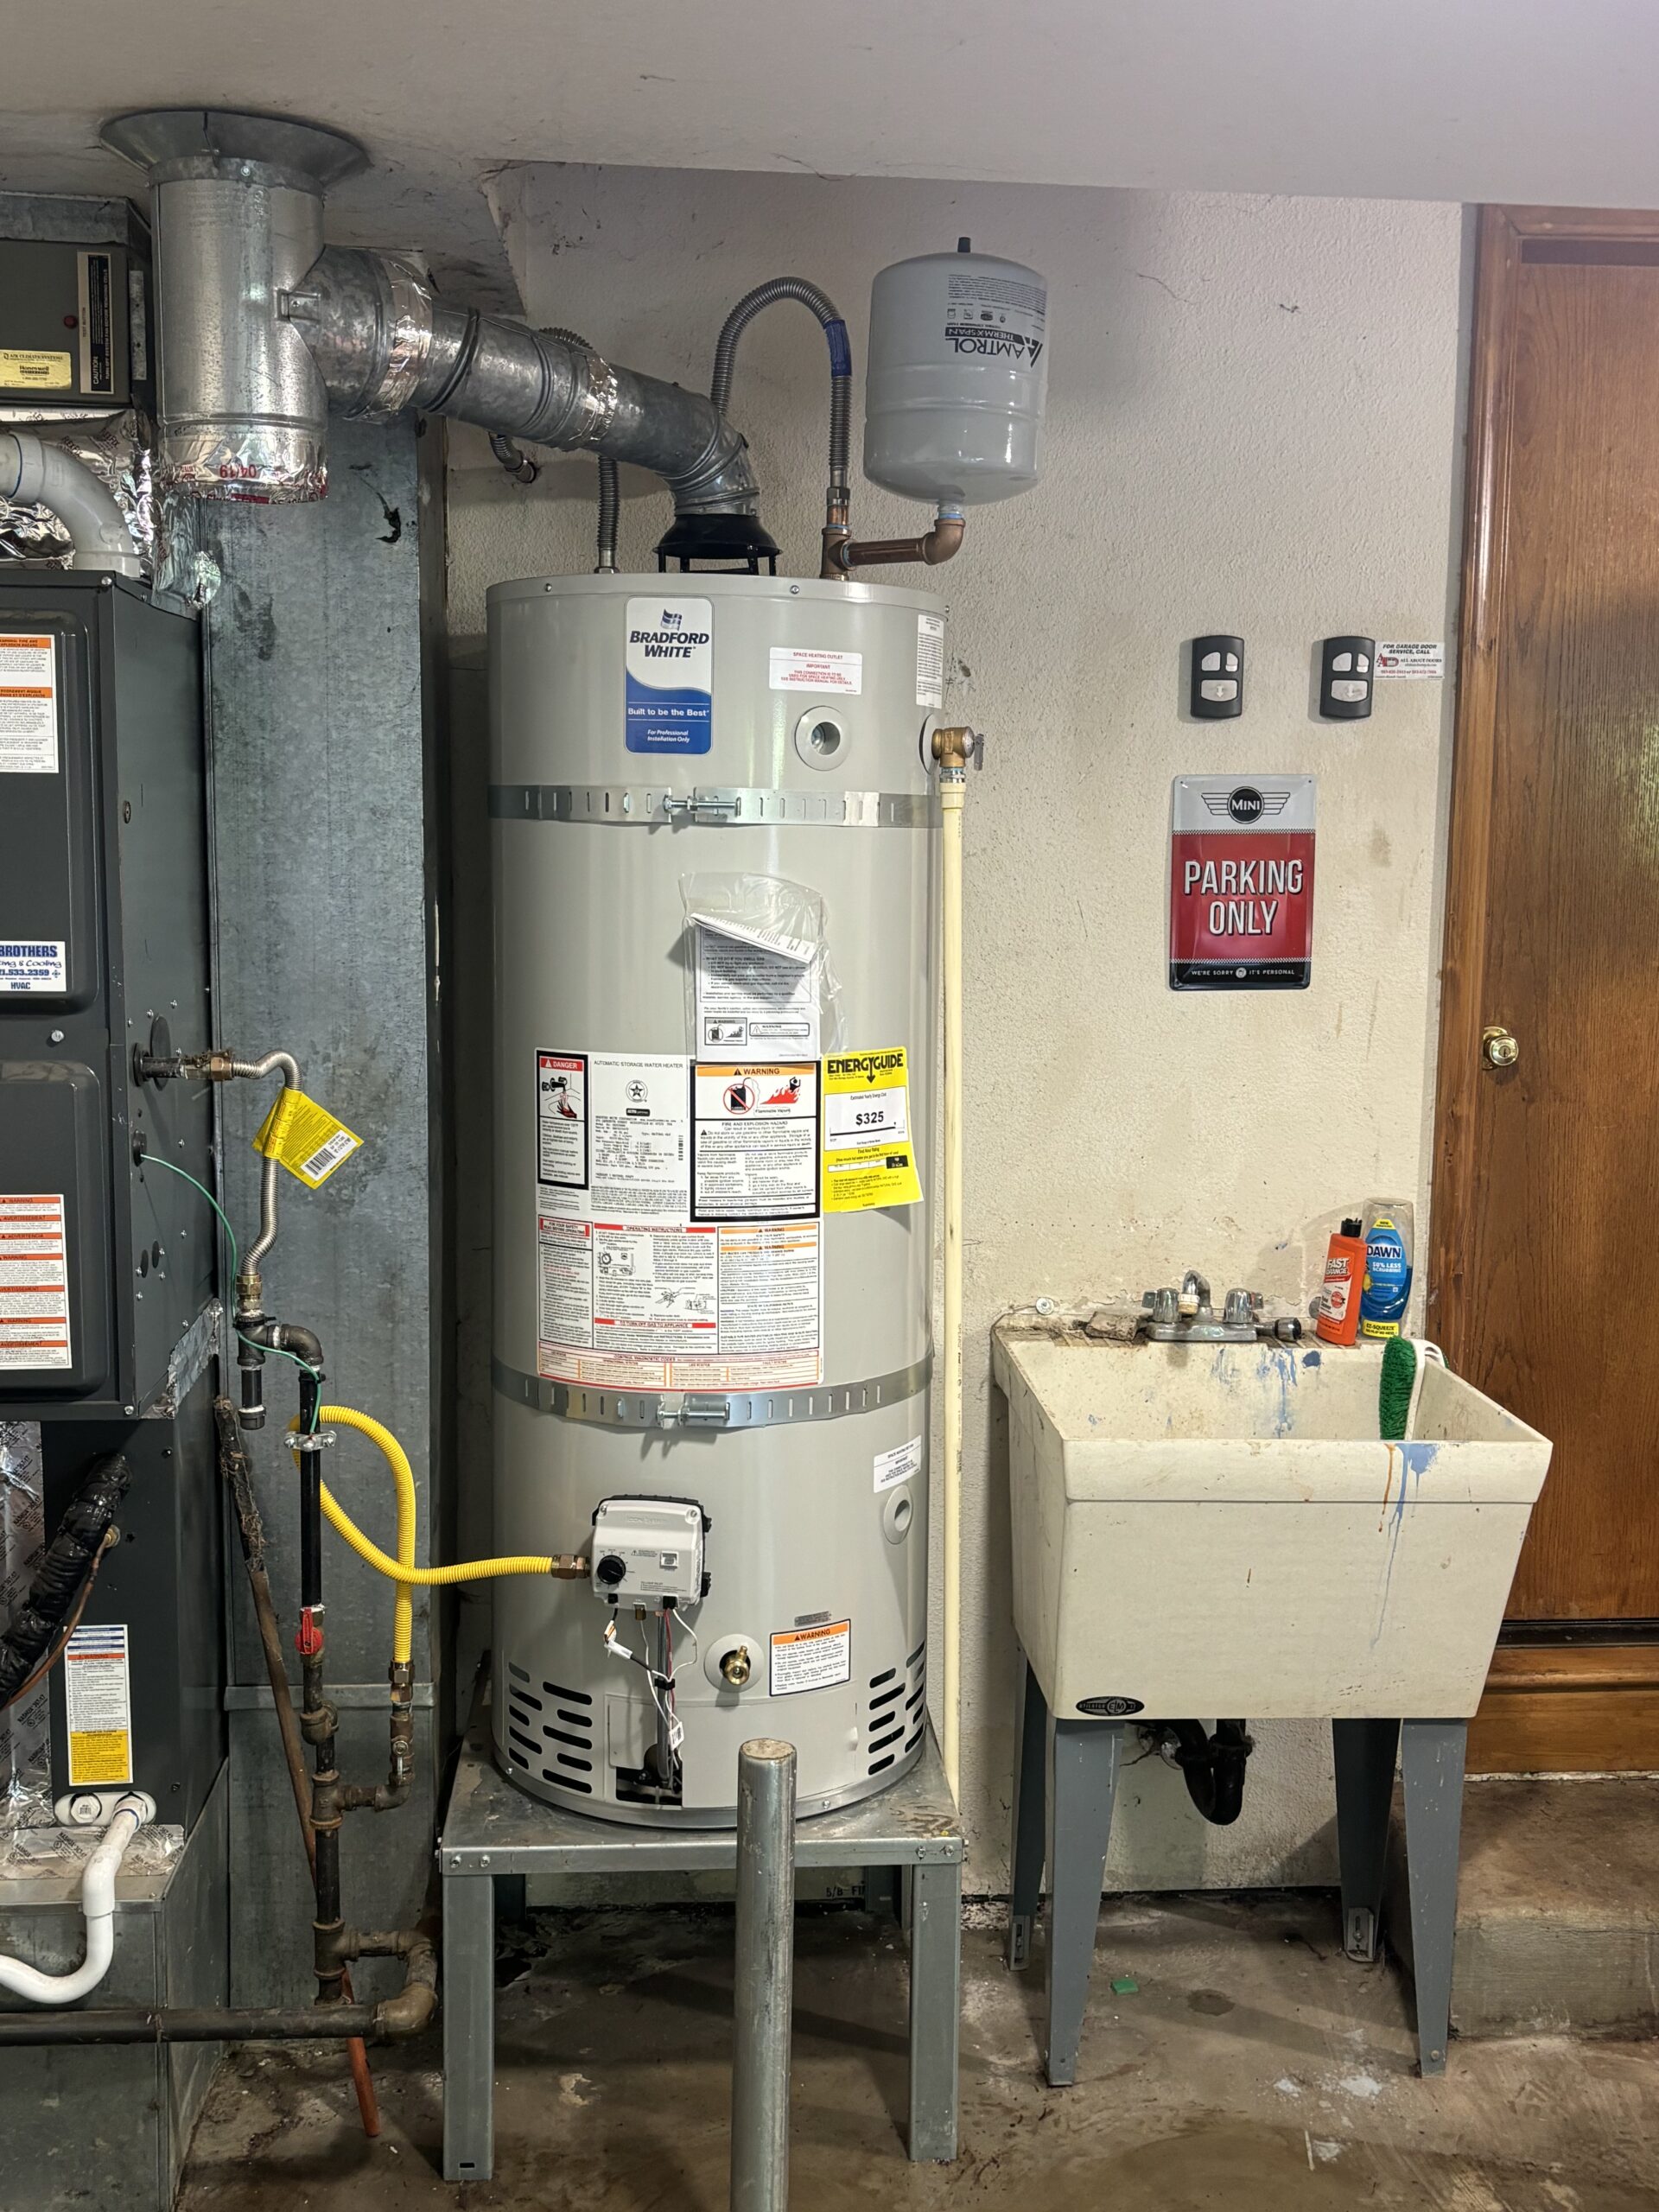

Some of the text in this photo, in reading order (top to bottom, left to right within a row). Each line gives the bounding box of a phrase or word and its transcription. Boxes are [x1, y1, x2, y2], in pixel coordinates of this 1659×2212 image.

[945, 338, 1025, 359] AMTROL
[219, 464, 257, 479] 04/19
[630, 631, 709, 645] BRADFORD
[644, 645, 692, 658] WHITE
[1231, 798, 1261, 811] MINI
[1184, 859, 1304, 896] PARKING
[1209, 899, 1279, 937] ONLY
[0, 944, 58, 957] BROTHERS
[25, 959, 62, 969] Cooling
[552, 1061, 578, 1070] DANGER
[855, 1111, 884, 1127] $325
[1366, 1245, 1402, 1258] DAWN
[1327, 1258, 1350, 1269] FAST
[799, 1629, 831, 1640] WARNING
